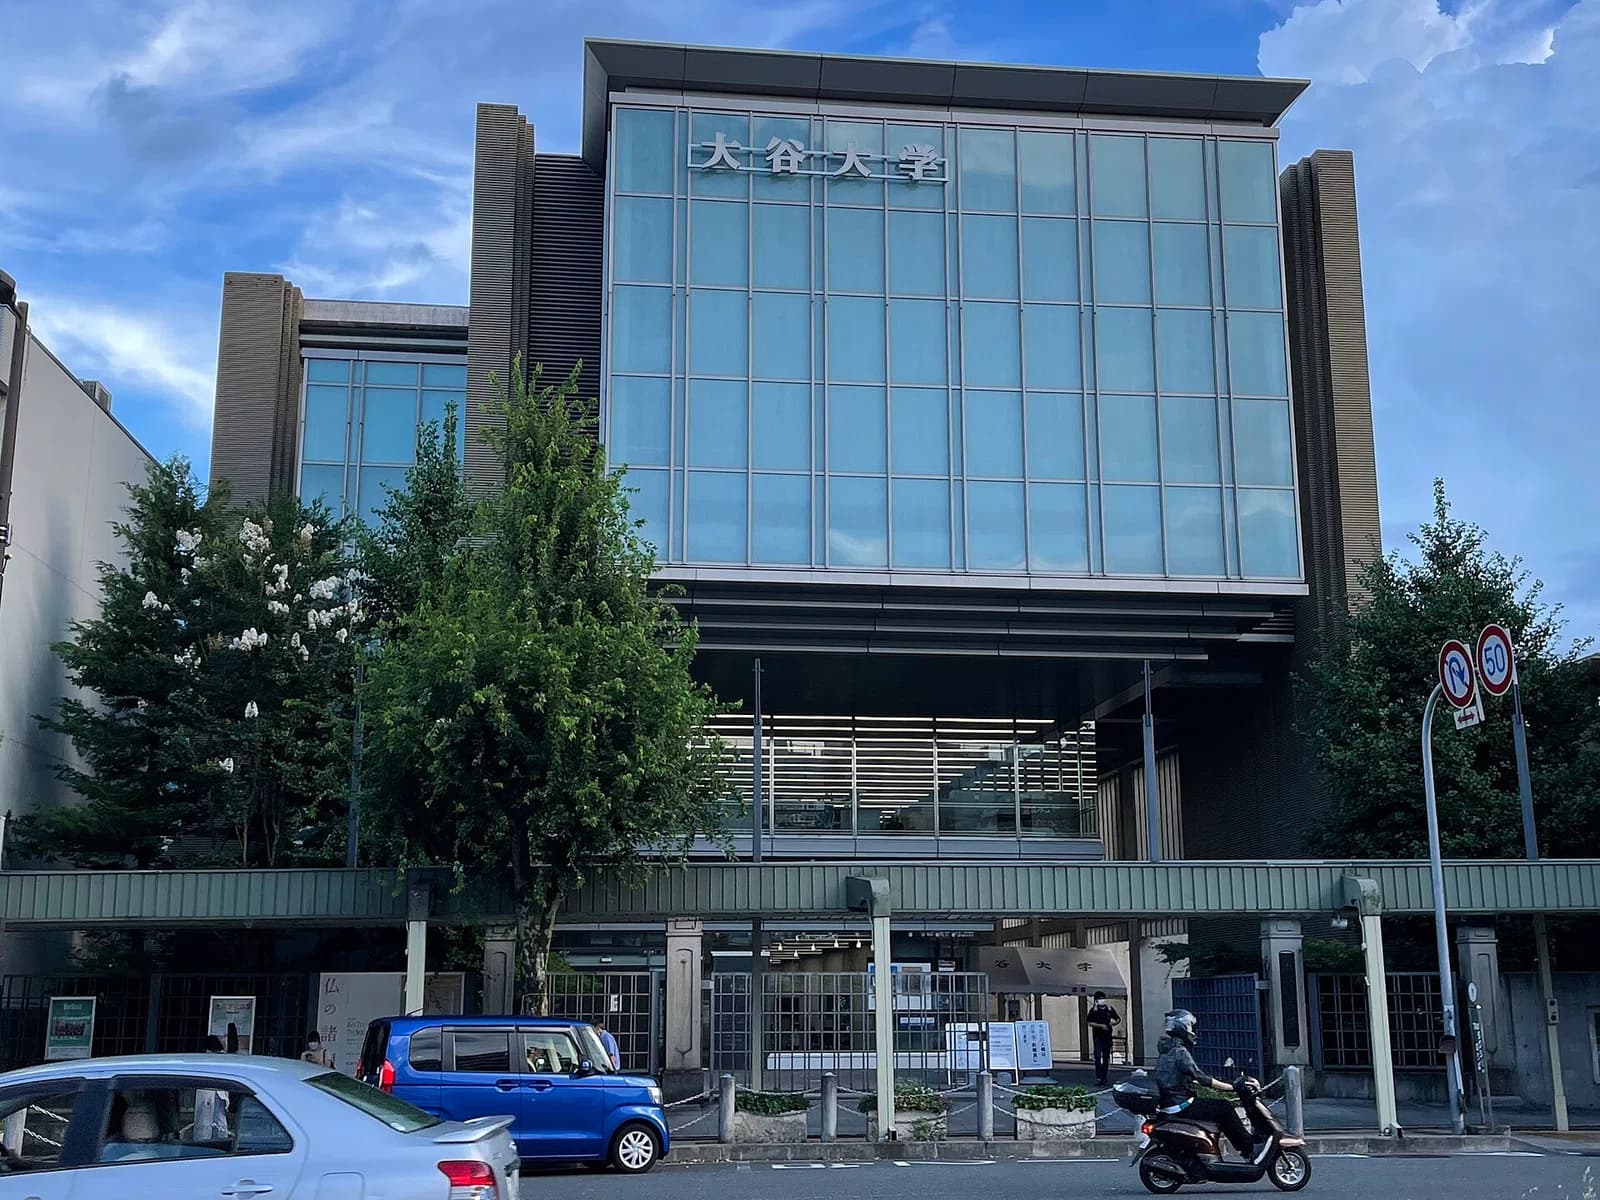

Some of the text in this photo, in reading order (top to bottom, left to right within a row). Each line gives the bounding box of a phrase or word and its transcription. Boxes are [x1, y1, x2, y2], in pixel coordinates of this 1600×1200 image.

[700, 131, 939, 181] 大谷大学
[1484, 644, 1505, 676] 50
